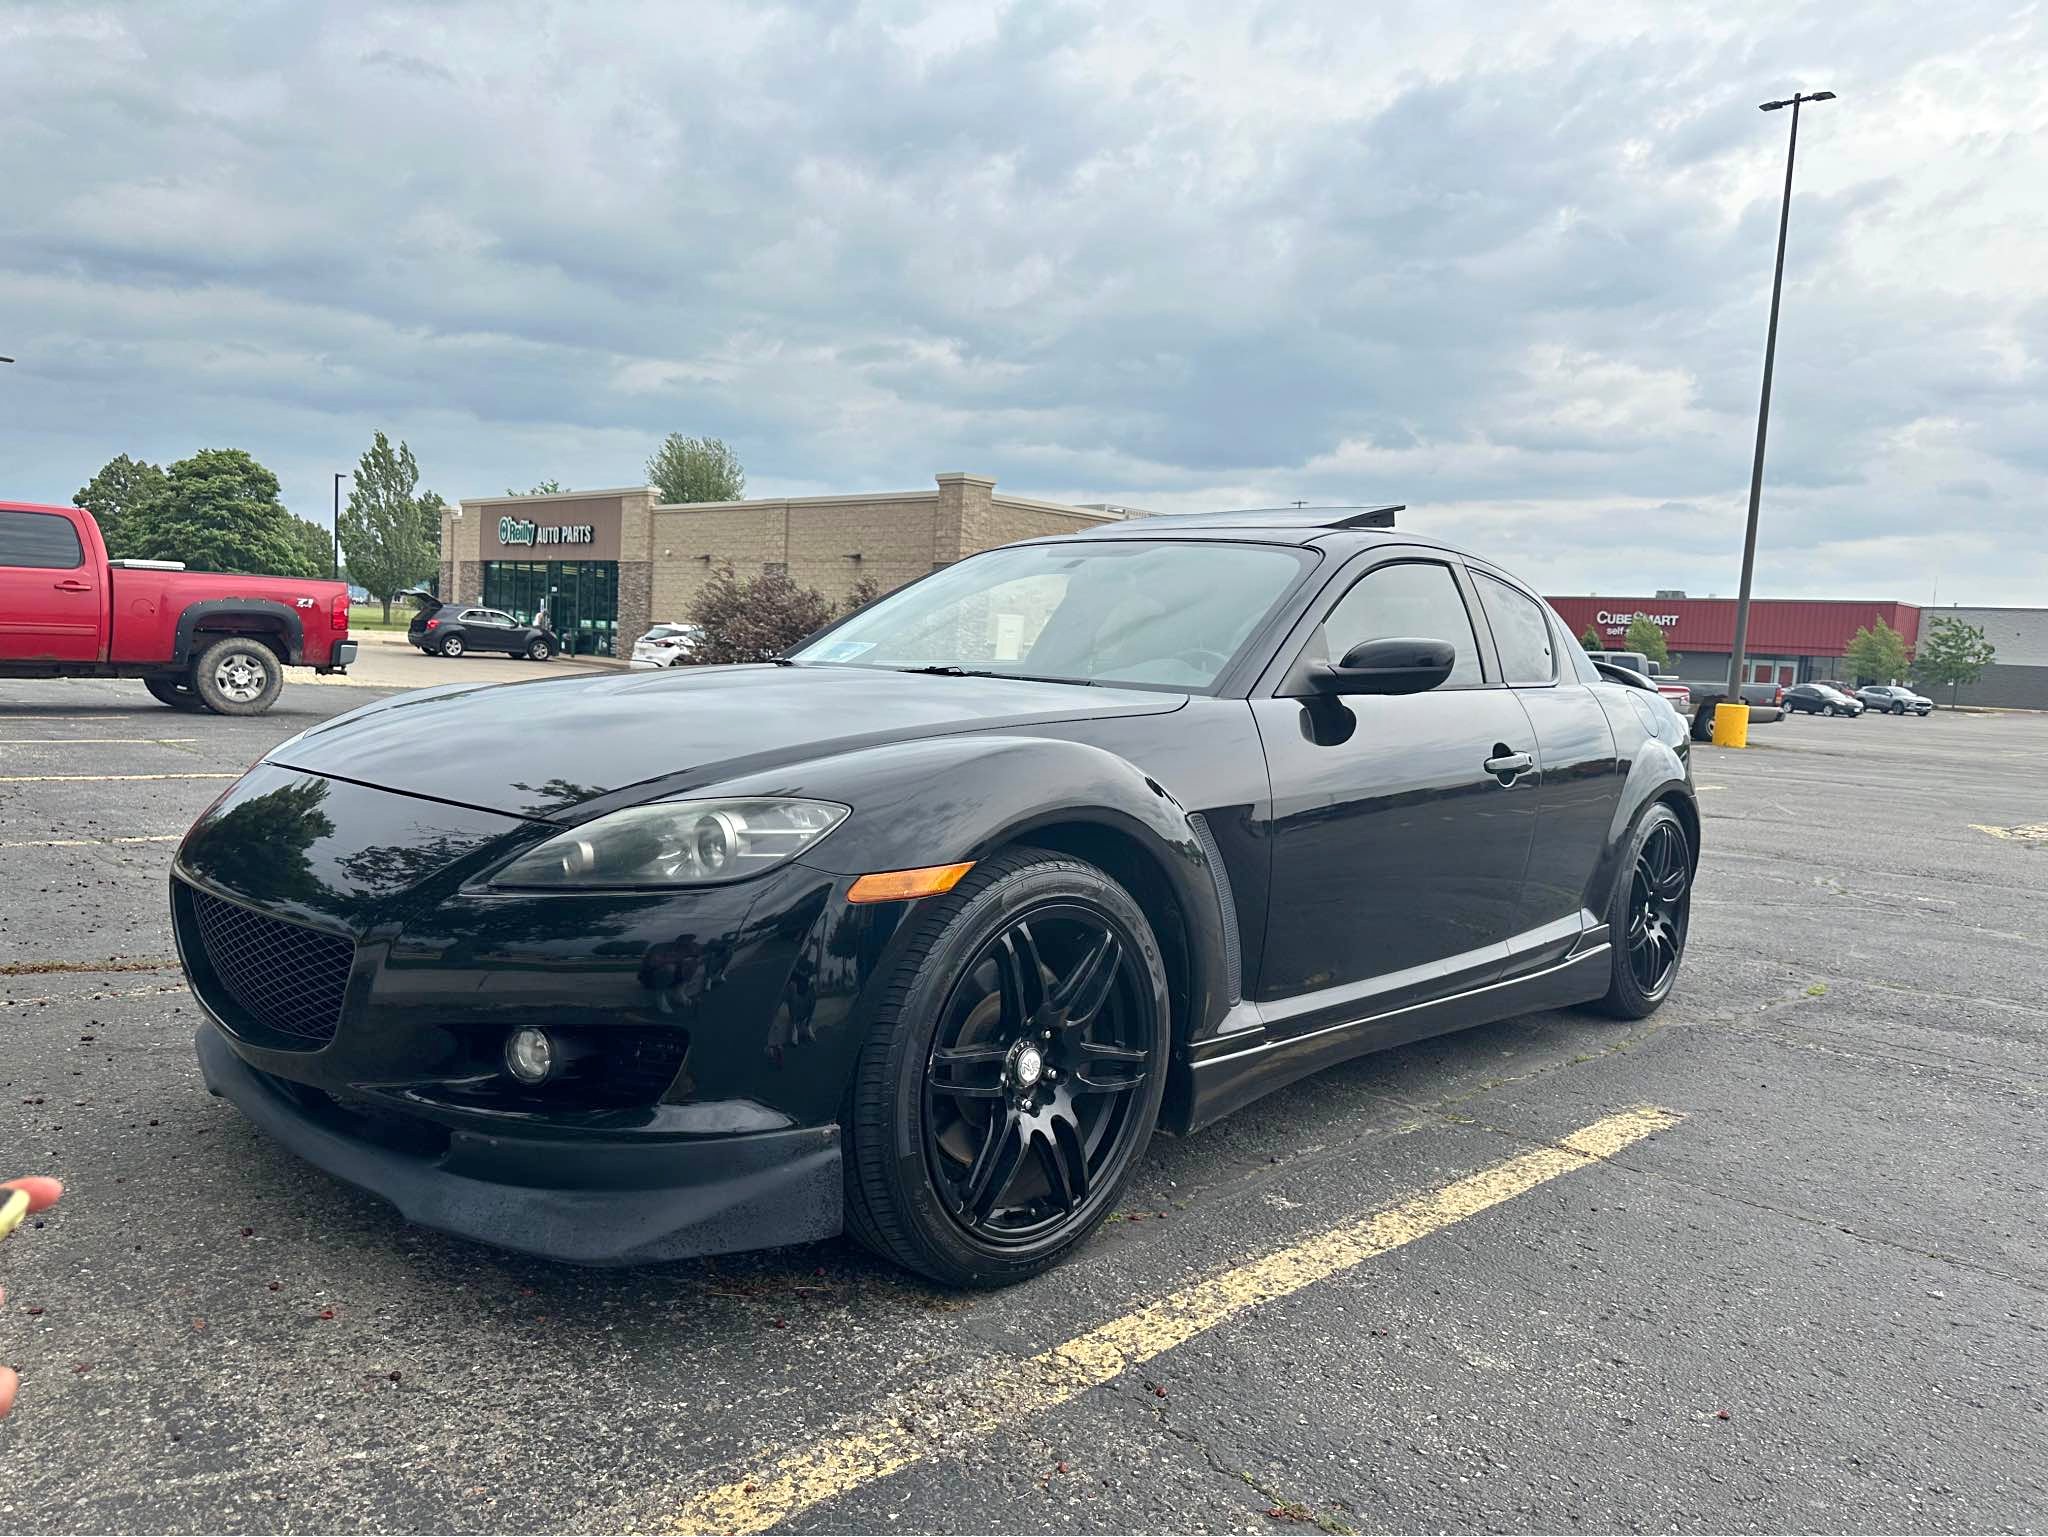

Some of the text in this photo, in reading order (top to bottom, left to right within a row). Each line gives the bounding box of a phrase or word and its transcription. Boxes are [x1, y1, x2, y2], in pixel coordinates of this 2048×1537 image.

[499, 516, 592, 546] O'Reilly AUTO PARTS
[1606, 626, 1625, 635] self
